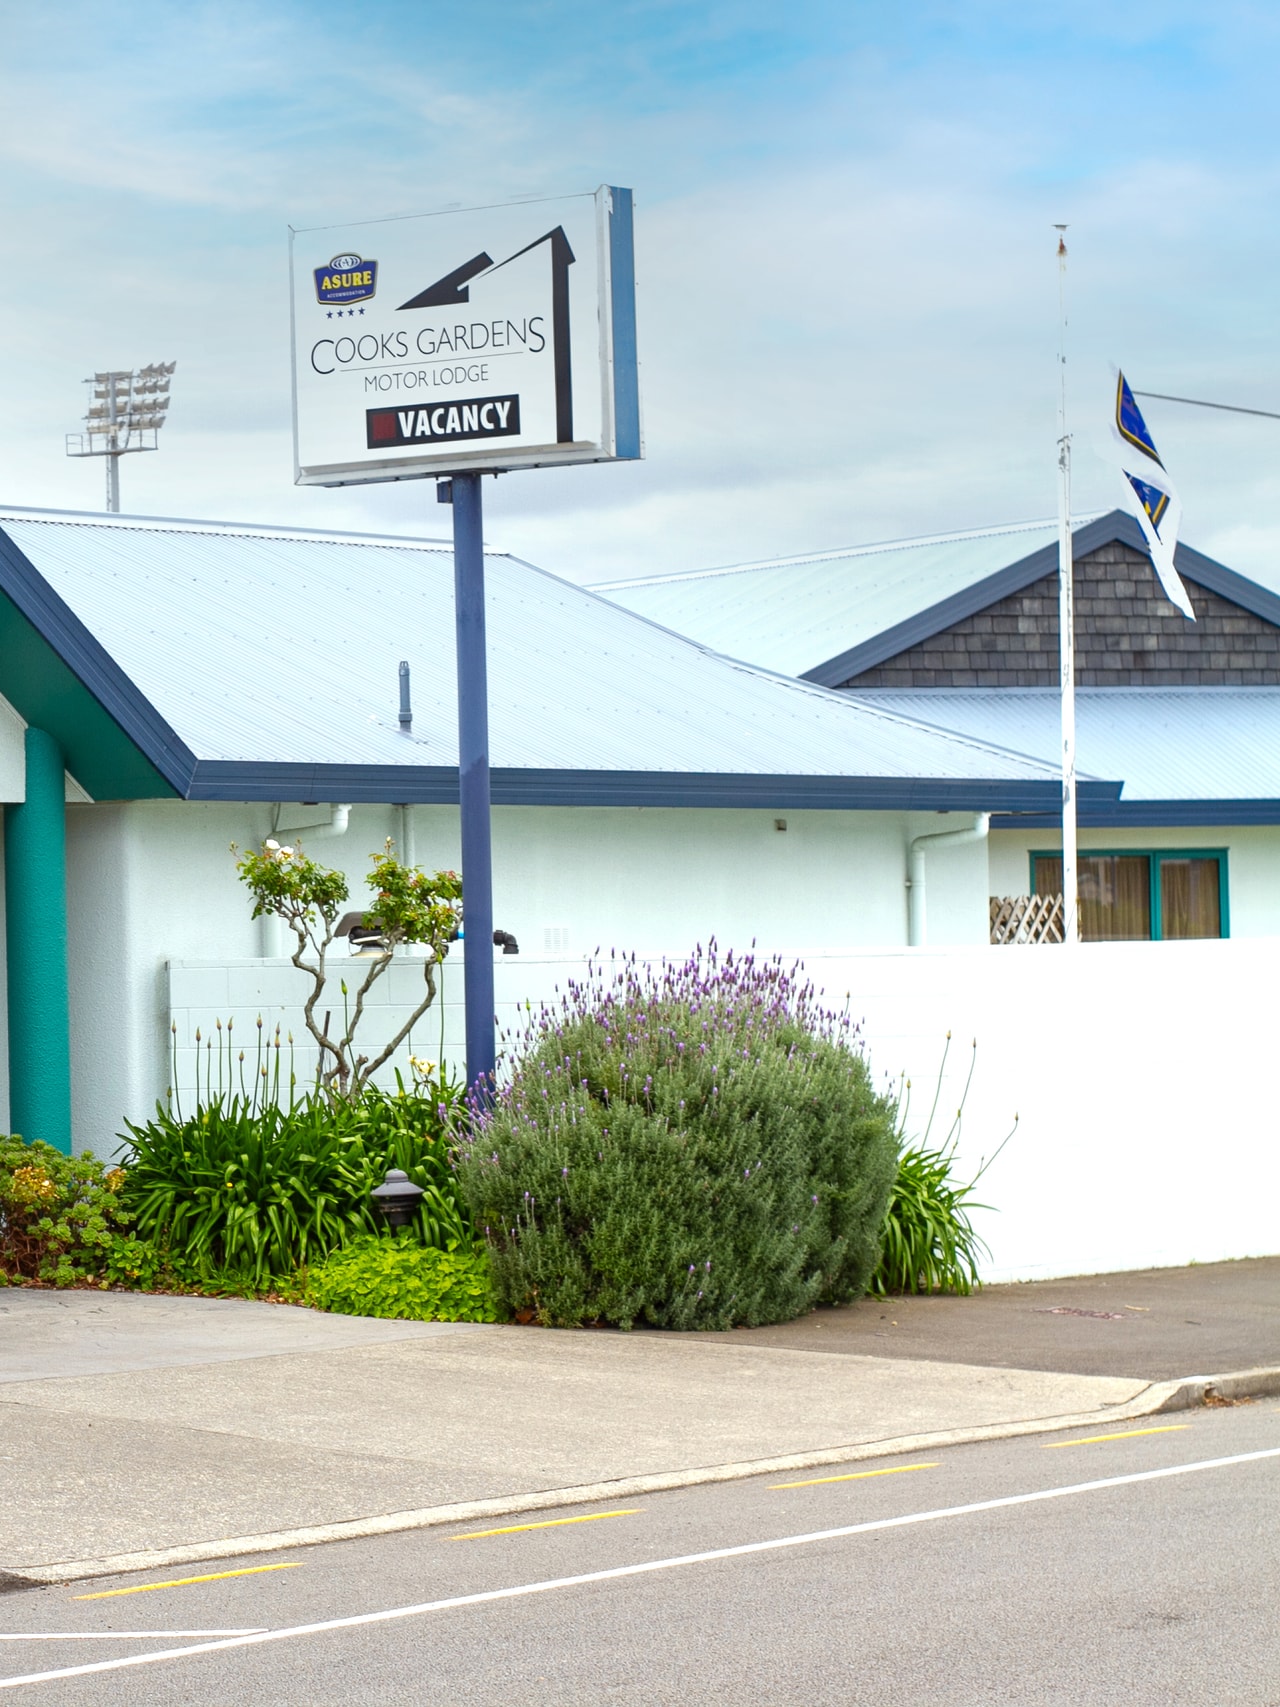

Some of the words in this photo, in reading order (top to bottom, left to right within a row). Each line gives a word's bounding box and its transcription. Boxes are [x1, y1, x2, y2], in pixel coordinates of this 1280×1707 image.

[321, 271, 372, 290] ASURE
[311, 331, 408, 375] COOKS
[416, 316, 546, 355] GARDENS
[364, 370, 429, 393] MOTOR
[433, 364, 489, 386] LODGE
[398, 401, 511, 438] VACANCY
